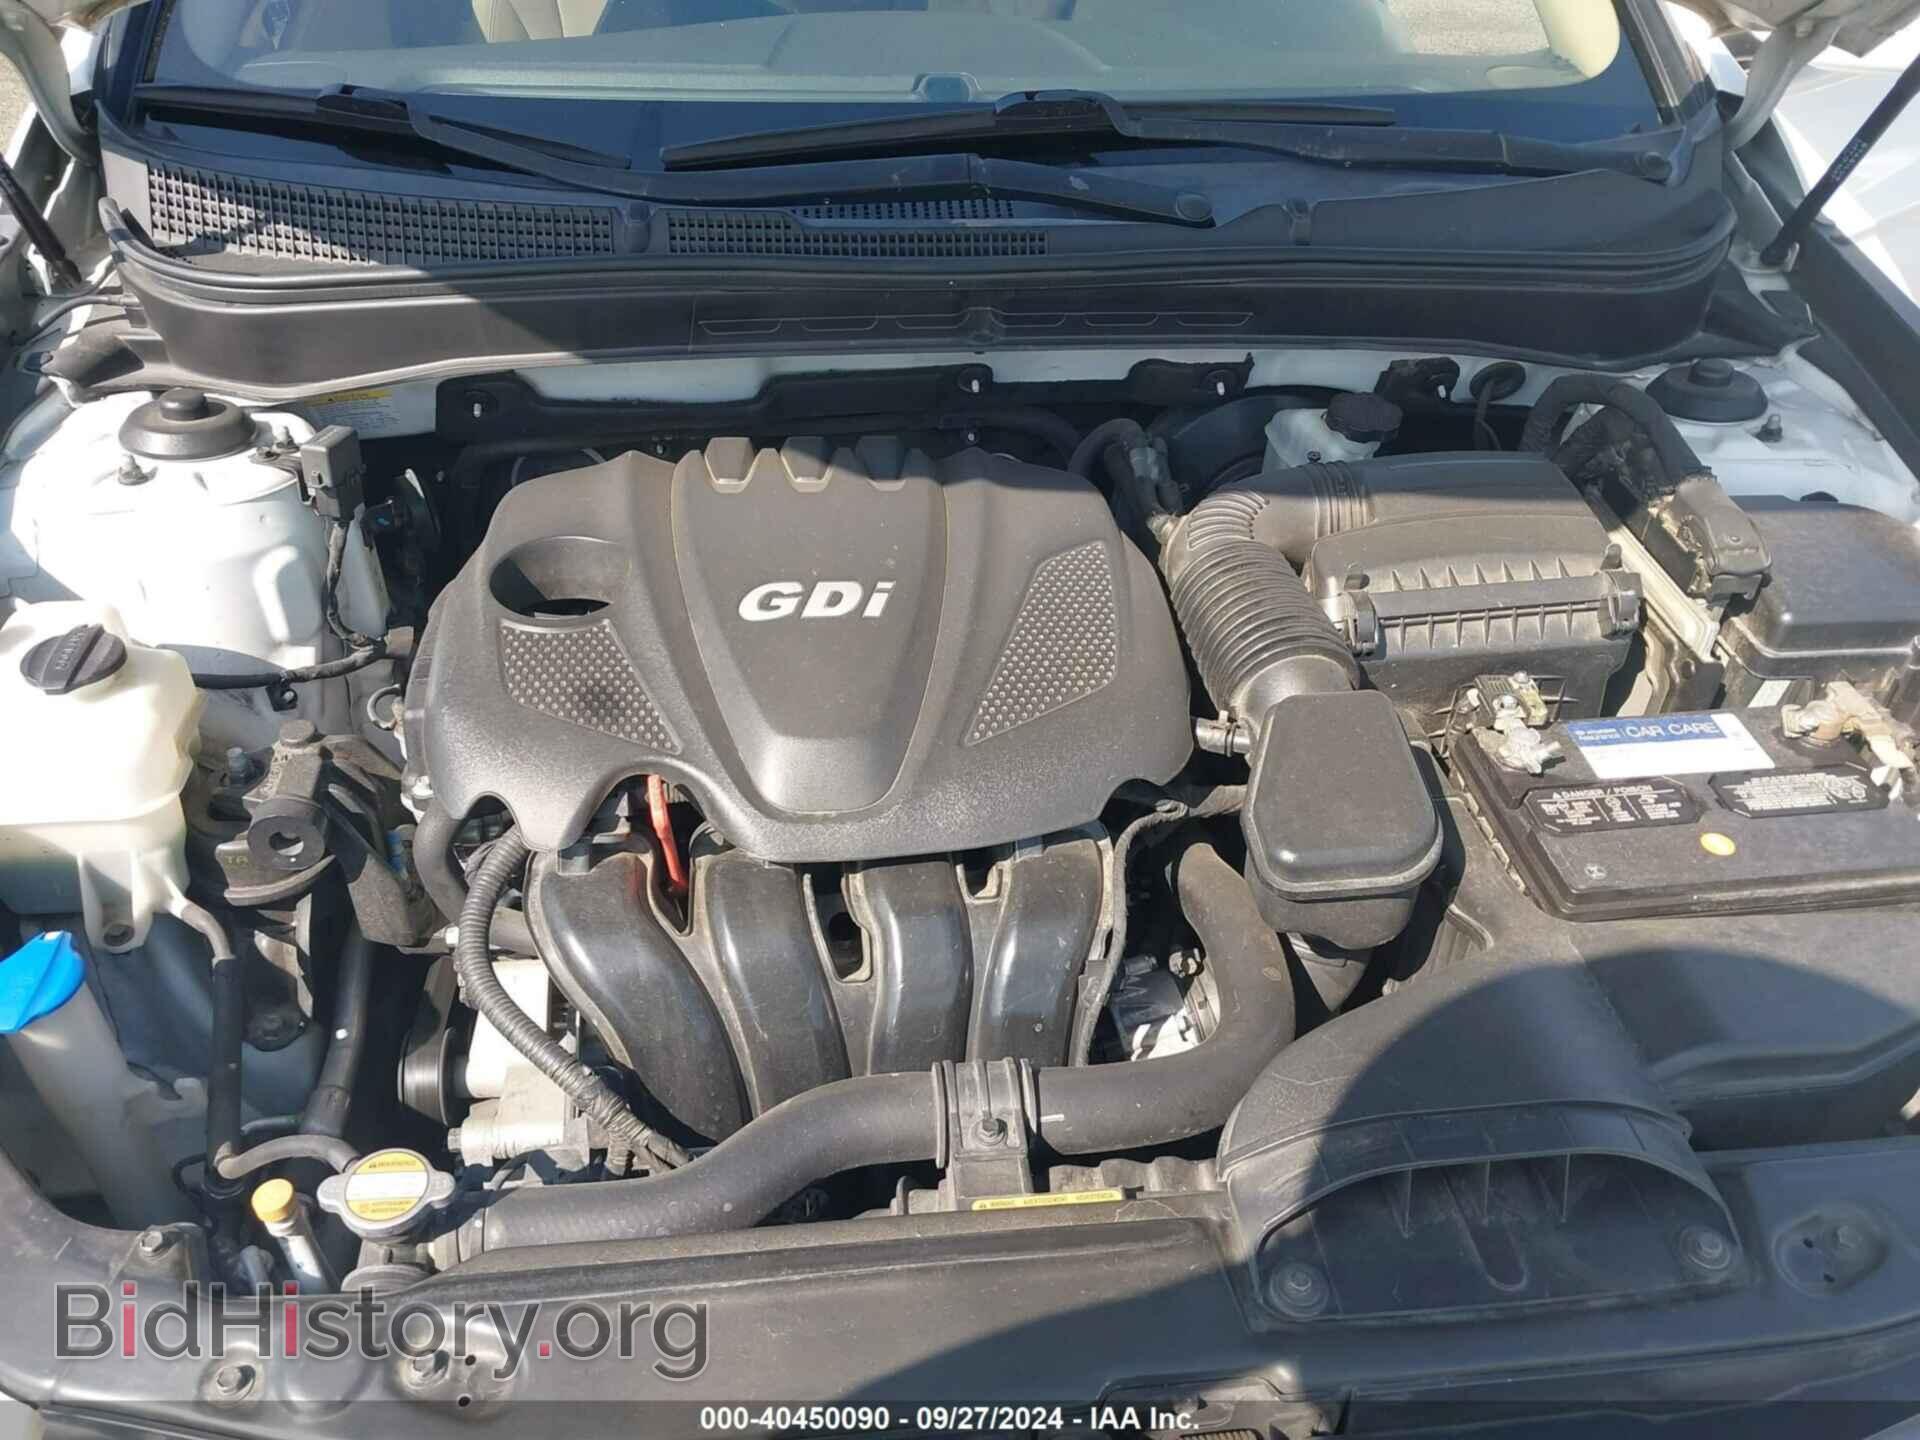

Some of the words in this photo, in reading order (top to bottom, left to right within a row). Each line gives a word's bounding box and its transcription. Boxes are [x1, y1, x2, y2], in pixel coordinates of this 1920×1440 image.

[738, 580, 896, 621] GDi
[1624, 725, 1665, 738] CAR
[1667, 721, 1721, 736] CARE
[1561, 788, 1606, 800] DANGER
